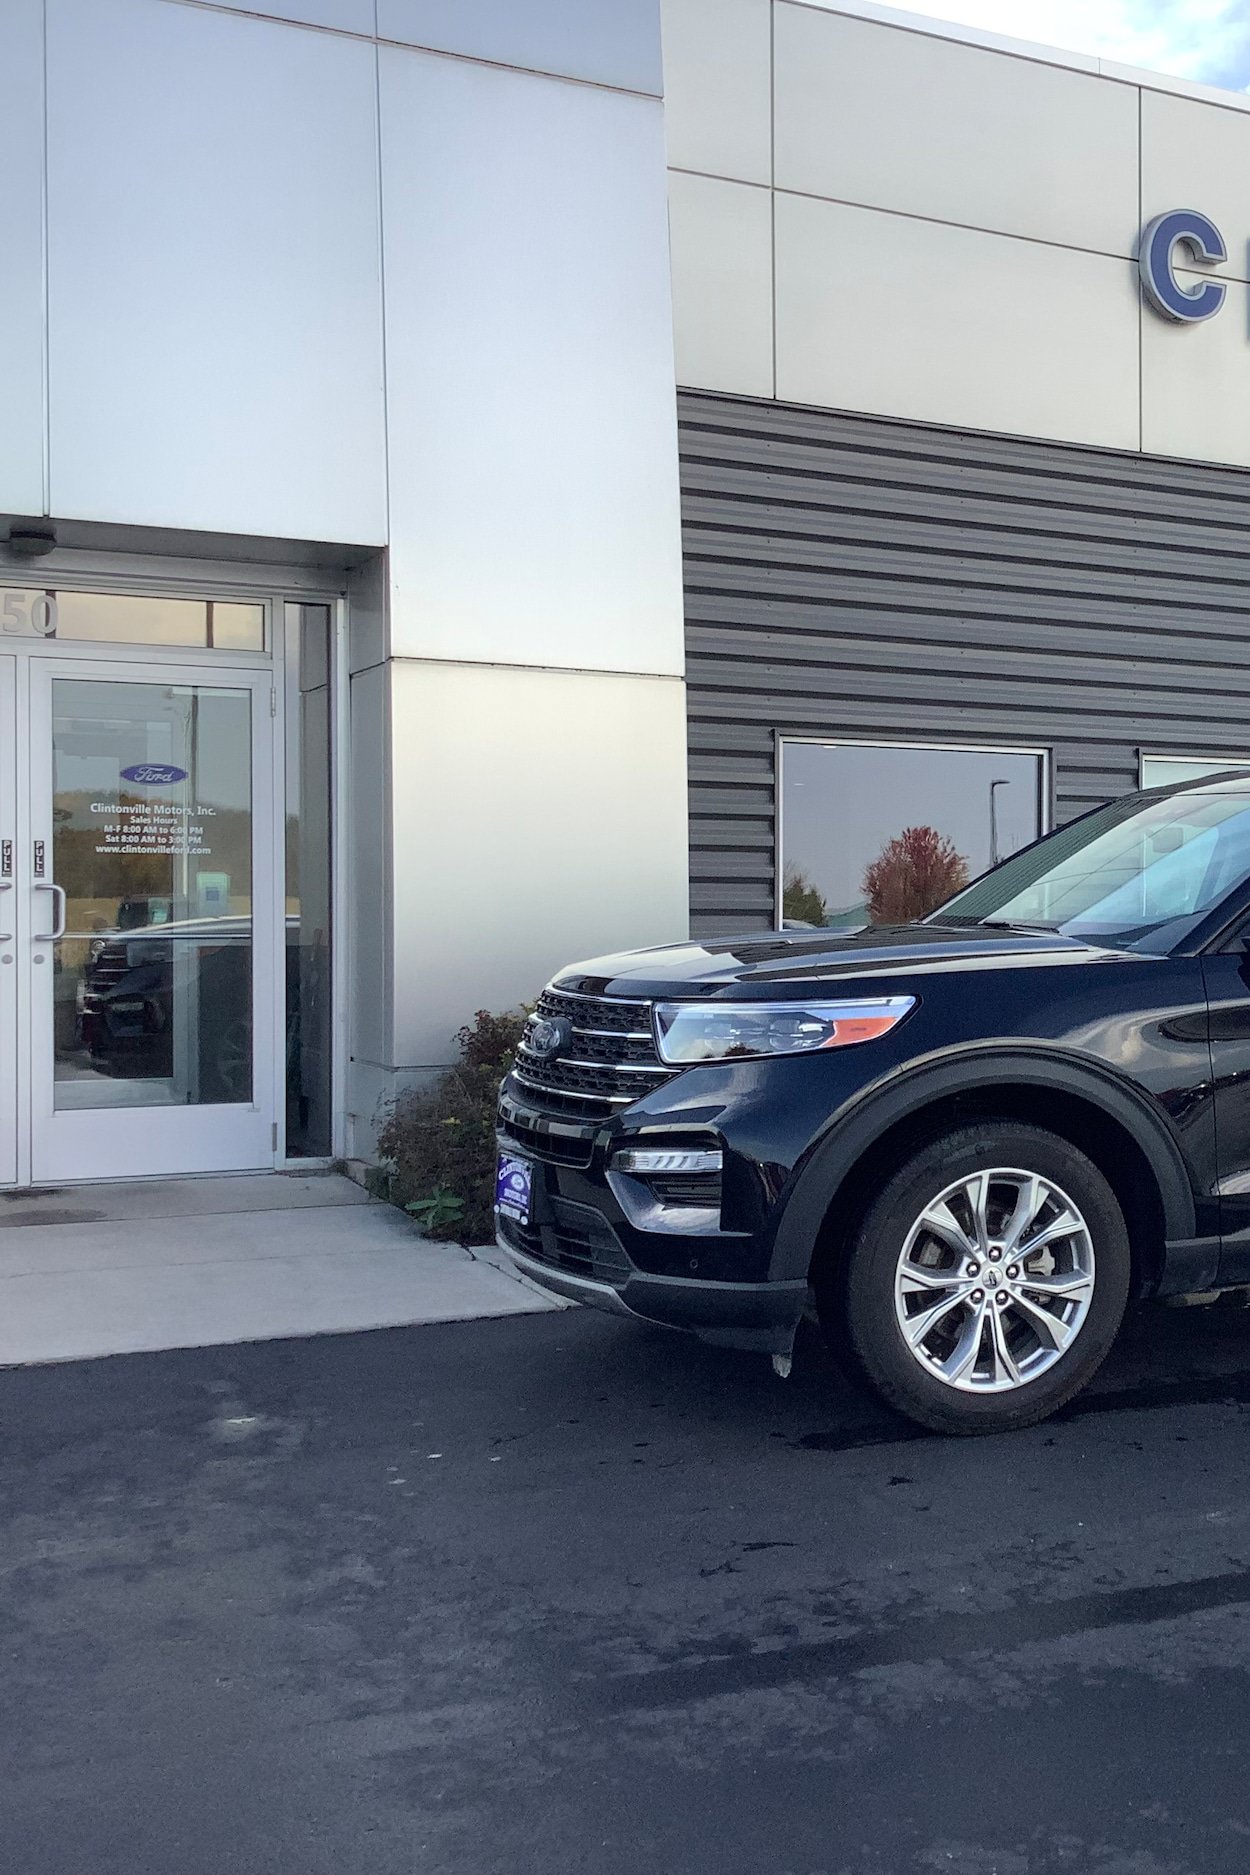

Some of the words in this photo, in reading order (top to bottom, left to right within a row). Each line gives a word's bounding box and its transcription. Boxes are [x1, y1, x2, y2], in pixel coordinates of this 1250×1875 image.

[134, 766, 175, 782] Ford
[90, 803, 152, 814] Clintonville
[153, 805, 195, 816] Motors,
[197, 806, 217, 816] Inc.
[130, 816, 152, 824] Sales
[153, 817, 178, 825] Hours
[104, 825, 121, 833] M-F
[122, 825, 141, 833] 8:00
[142, 826, 158, 834] AM
[159, 826, 169, 834] to
[169, 826, 188, 834] 6:00
[189, 827, 204, 835] PM
[105, 834, 120, 843] Sat
[121, 835, 140, 843] 8:00
[140, 835, 156, 843] AM
[157, 836, 167, 844] to
[168, 836, 187, 844] 3:00
[188, 836, 202, 844] PM
[95, 845, 212, 855] www.clintonvilleford.com
[35, 841, 44, 872] PULL
